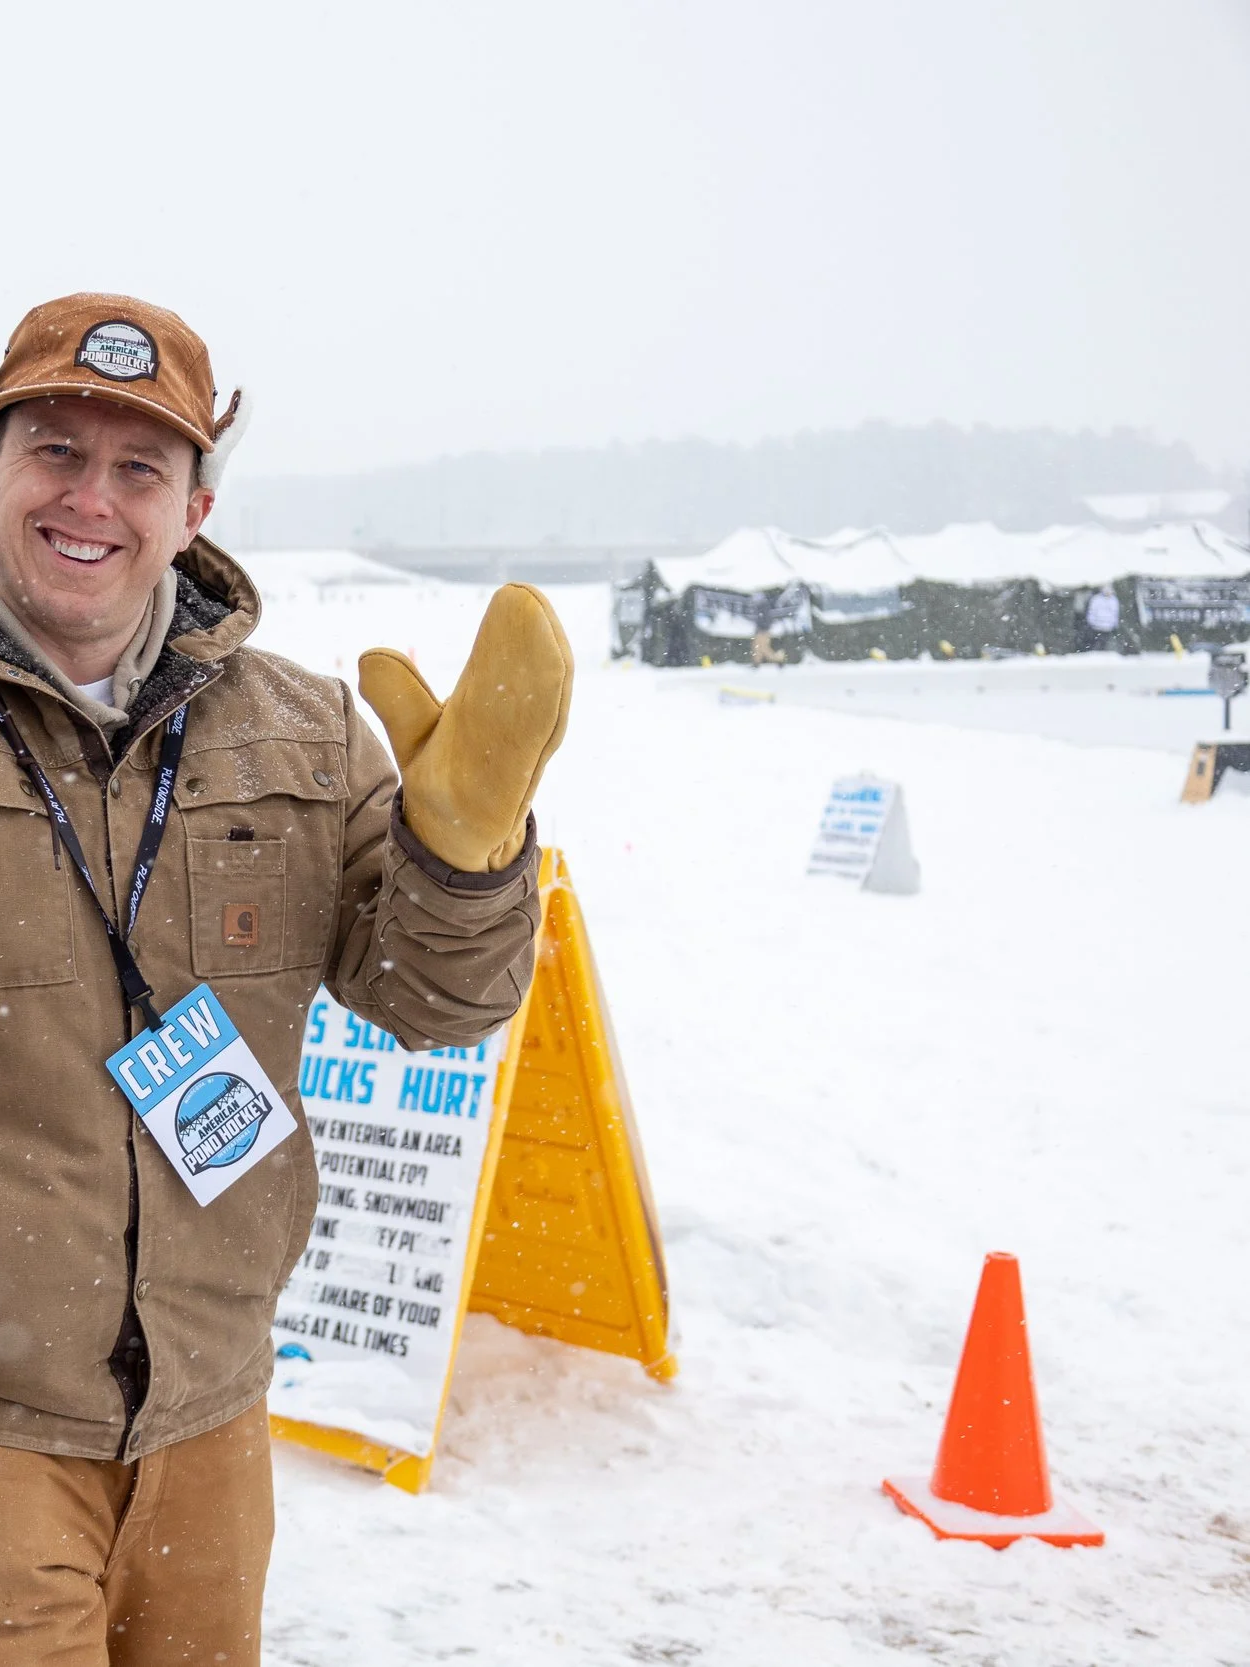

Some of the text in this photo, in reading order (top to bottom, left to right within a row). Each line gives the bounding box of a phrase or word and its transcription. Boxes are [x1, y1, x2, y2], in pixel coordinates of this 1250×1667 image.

[80, 350, 111, 362] POND
[112, 353, 155, 374] HOCKEY
[99, 344, 138, 356] AMERICAN
[151, 767, 173, 825] PLAY OUTSIDE.
[135, 864, 148, 894] PLAY
[118, 997, 221, 1101] CREW
[398, 1065, 486, 1119] HURT
[184, 1093, 269, 1174] POND HOCKEY
[198, 1100, 240, 1140] AMERICAN
[329, 1119, 398, 1149] ENTERING
[400, 1127, 423, 1152] AN
[423, 1132, 463, 1158] AREA
[319, 1150, 396, 1182] POTENTIAL
[364, 1190, 451, 1224] SNOWMOBI
[315, 1249, 332, 1272] OF
[318, 1283, 369, 1313] AWARE
[372, 1294, 394, 1318] OF
[397, 1299, 441, 1328] YOUR
[310, 1315, 330, 1339] AT
[331, 1320, 360, 1347] ALL
[363, 1326, 410, 1358] TIMES
